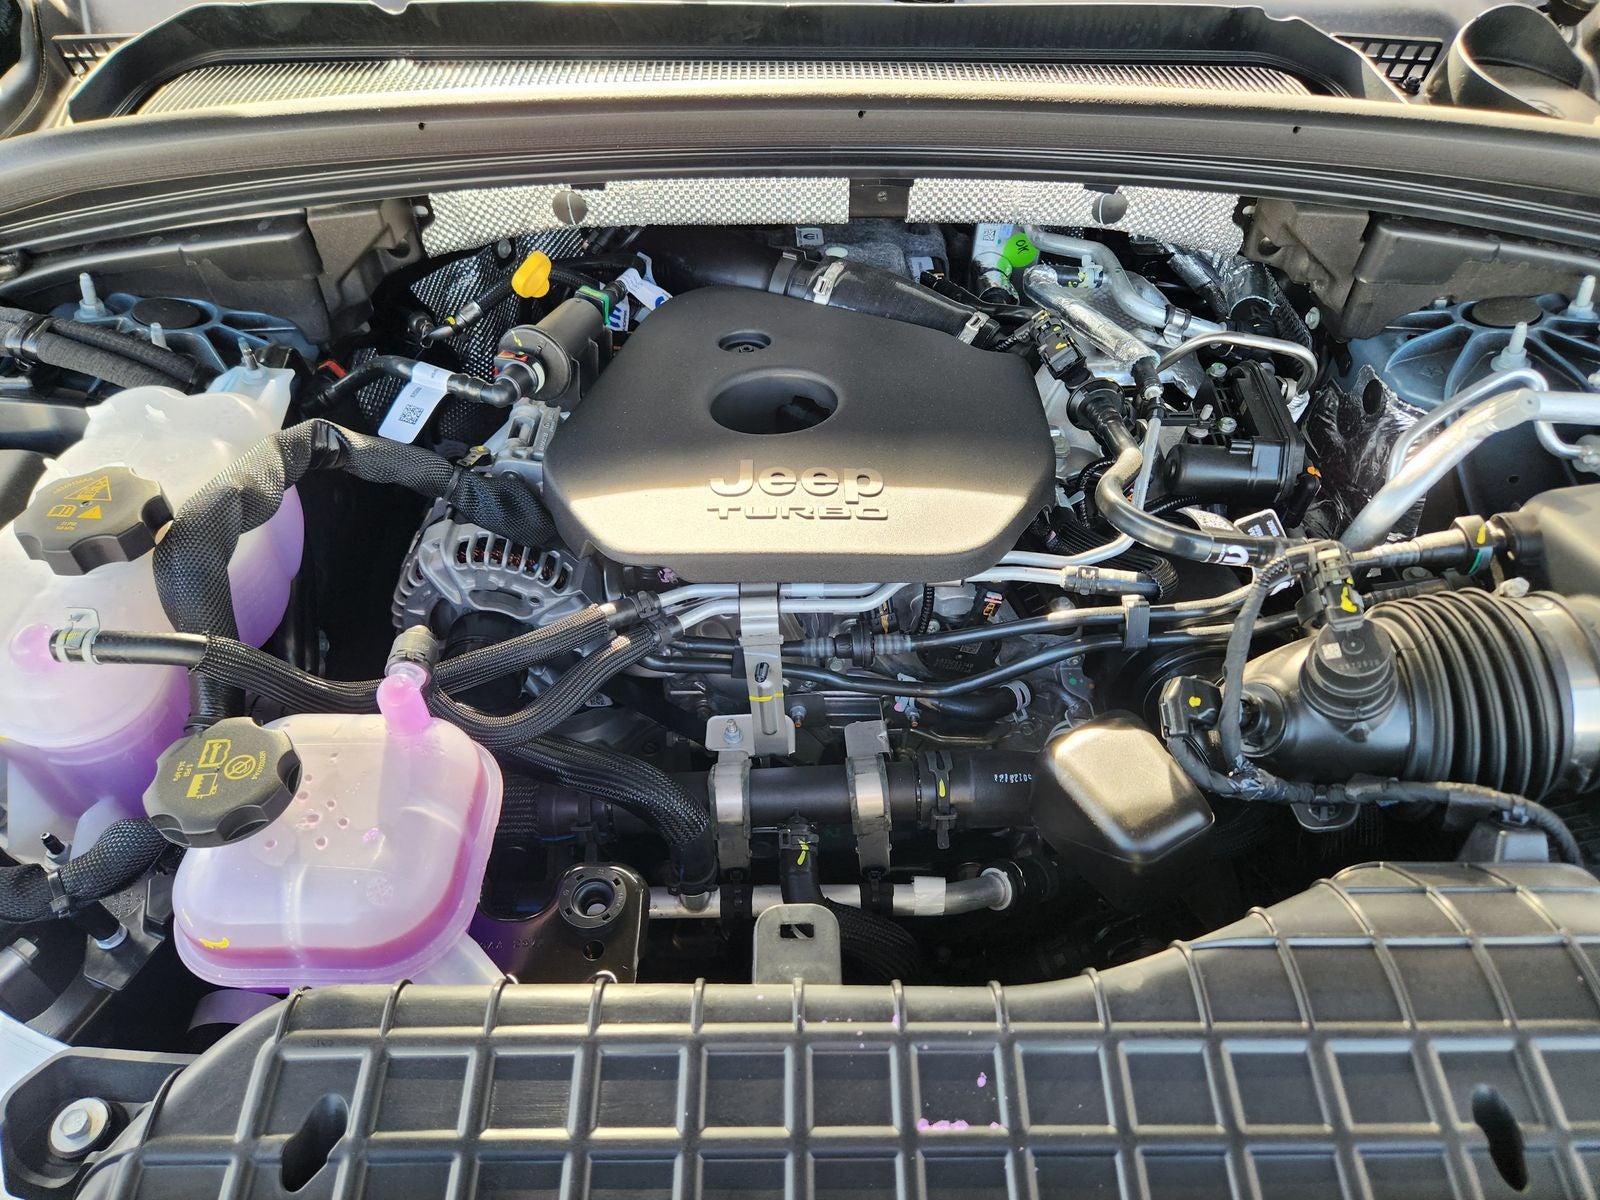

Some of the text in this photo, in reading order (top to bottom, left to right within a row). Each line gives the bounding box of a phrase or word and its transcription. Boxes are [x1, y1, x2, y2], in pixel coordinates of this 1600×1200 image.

[1015, 239, 1030, 255] OK
[709, 459, 884, 504] Jeep
[707, 505, 888, 521] TURBO
